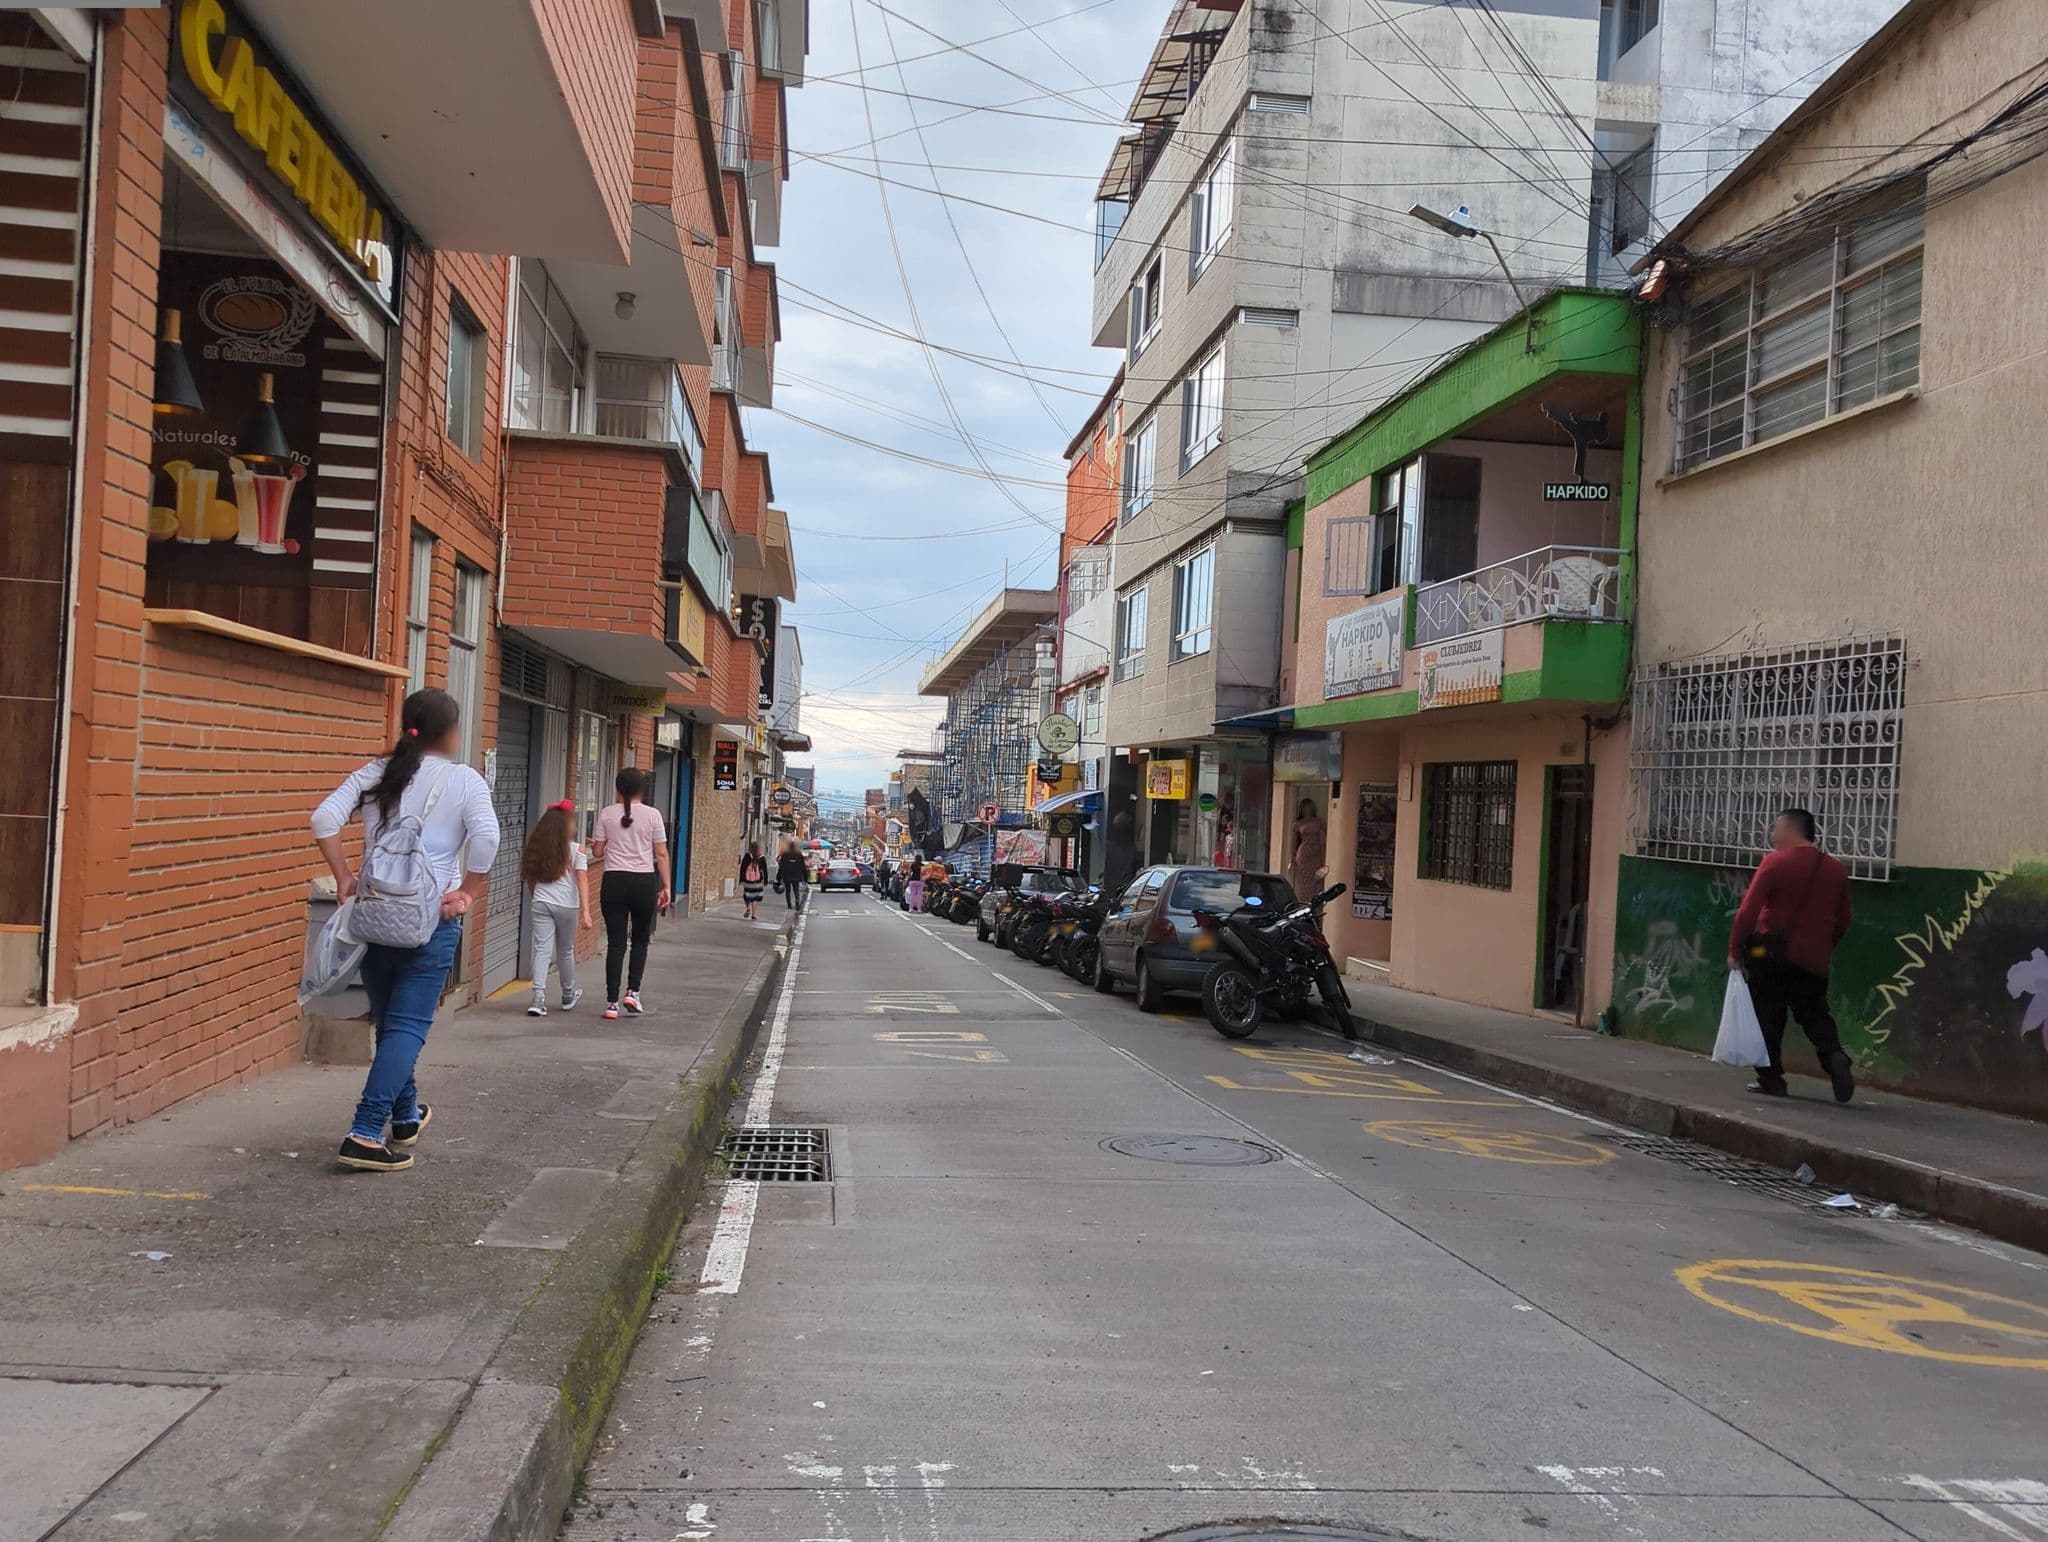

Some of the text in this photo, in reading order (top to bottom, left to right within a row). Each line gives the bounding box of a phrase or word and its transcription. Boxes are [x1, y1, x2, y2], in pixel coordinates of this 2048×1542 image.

[180, 0, 384, 284] CAFETERIA
[152, 427, 239, 447] Naturales
[1547, 485, 1608, 499] HAPKIDO
[1341, 621, 1383, 648] HAPKIDO
